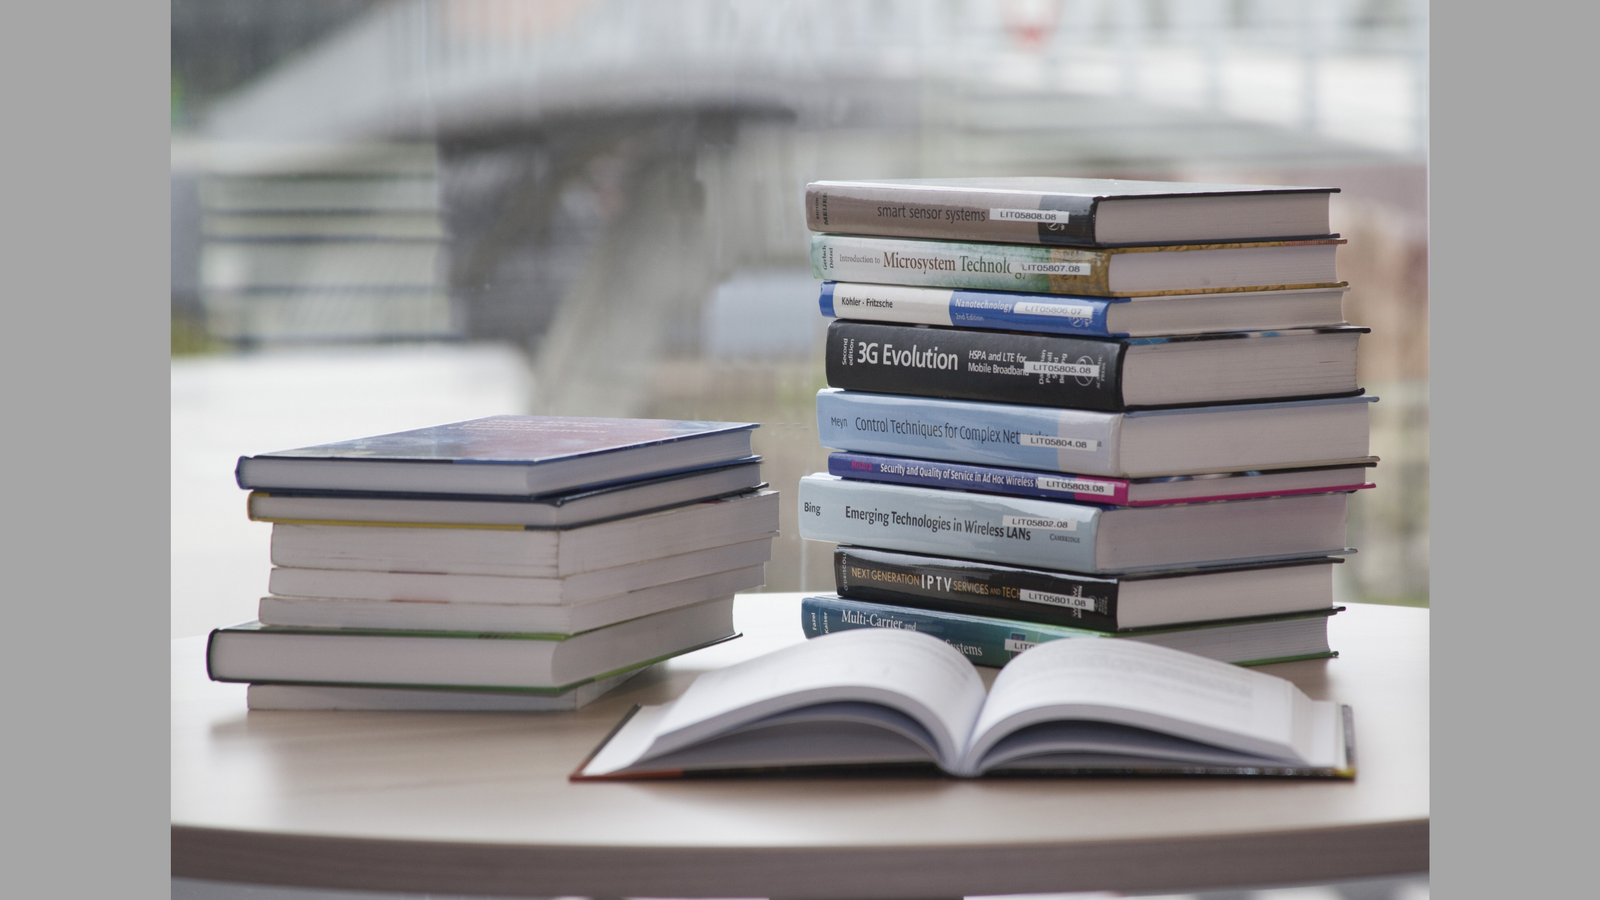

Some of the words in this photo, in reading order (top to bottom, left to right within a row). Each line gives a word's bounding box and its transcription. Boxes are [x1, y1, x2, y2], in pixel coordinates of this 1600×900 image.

[877, 205, 906, 218] smart
[909, 207, 942, 220] sensor
[945, 208, 986, 224] systems
[1000, 211, 1057, 221] LIT05808.08
[839, 253, 874, 264] Introduction
[874, 256, 881, 264] to
[883, 251, 956, 275] Microsystem
[959, 255, 1026, 280] Technol
[1021, 263, 1081, 273] LIT05807.08
[841, 296, 861, 307] Köhler
[866, 298, 893, 309] Fritzsche
[954, 298, 1013, 313] Nanotechnology
[1025, 305, 1083, 315] LIT05806.07
[955, 312, 966, 321] 2nd
[966, 313, 985, 322] Edition
[857, 341, 879, 365] 3G
[882, 343, 959, 371] Evolution
[968, 350, 987, 360] HSPA
[988, 351, 1002, 362] and
[1002, 352, 1015, 363] LTE
[1016, 352, 1027, 363] for
[967, 362, 992, 374] Mobile
[1033, 363, 1092, 375] LIT05805.08
[830, 416, 848, 429] Meyn
[855, 417, 889, 433] Control
[890, 419, 943, 439] Techniques
[944, 422, 958, 439] for
[959, 425, 1001, 445] Complex
[1030, 437, 1088, 449] LIT05804.08
[851, 460, 872, 471] Mishra
[880, 462, 905, 477] Security
[906, 464, 919, 476] and
[919, 466, 942, 480] Quality
[942, 467, 951, 479] of
[951, 470, 974, 482] Service
[974, 470, 982, 482] in
[982, 472, 991, 483] Ad
[992, 474, 1004, 485] Hoc
[1006, 475, 1034, 488] Wireless
[1046, 480, 1105, 493] LIT05803.08
[804, 501, 821, 516] Bing
[845, 505, 890, 527] Emerging
[891, 510, 951, 533] Technologies
[953, 517, 962, 532] in
[964, 519, 1005, 538] Wireless
[1006, 526, 1031, 541] LANs
[1012, 518, 1068, 529] LIT05802.08
[851, 566, 871, 580] NEXT
[871, 569, 920, 586] GENERATION
[921, 573, 952, 593] IPTV
[953, 580, 989, 596] SERVICES
[990, 588, 1001, 596] AND
[1028, 592, 1087, 608] LIT05801.08
[841, 609, 903, 630] Multi-Carrier
[904, 622, 917, 631] and
[945, 639, 983, 657] stems
